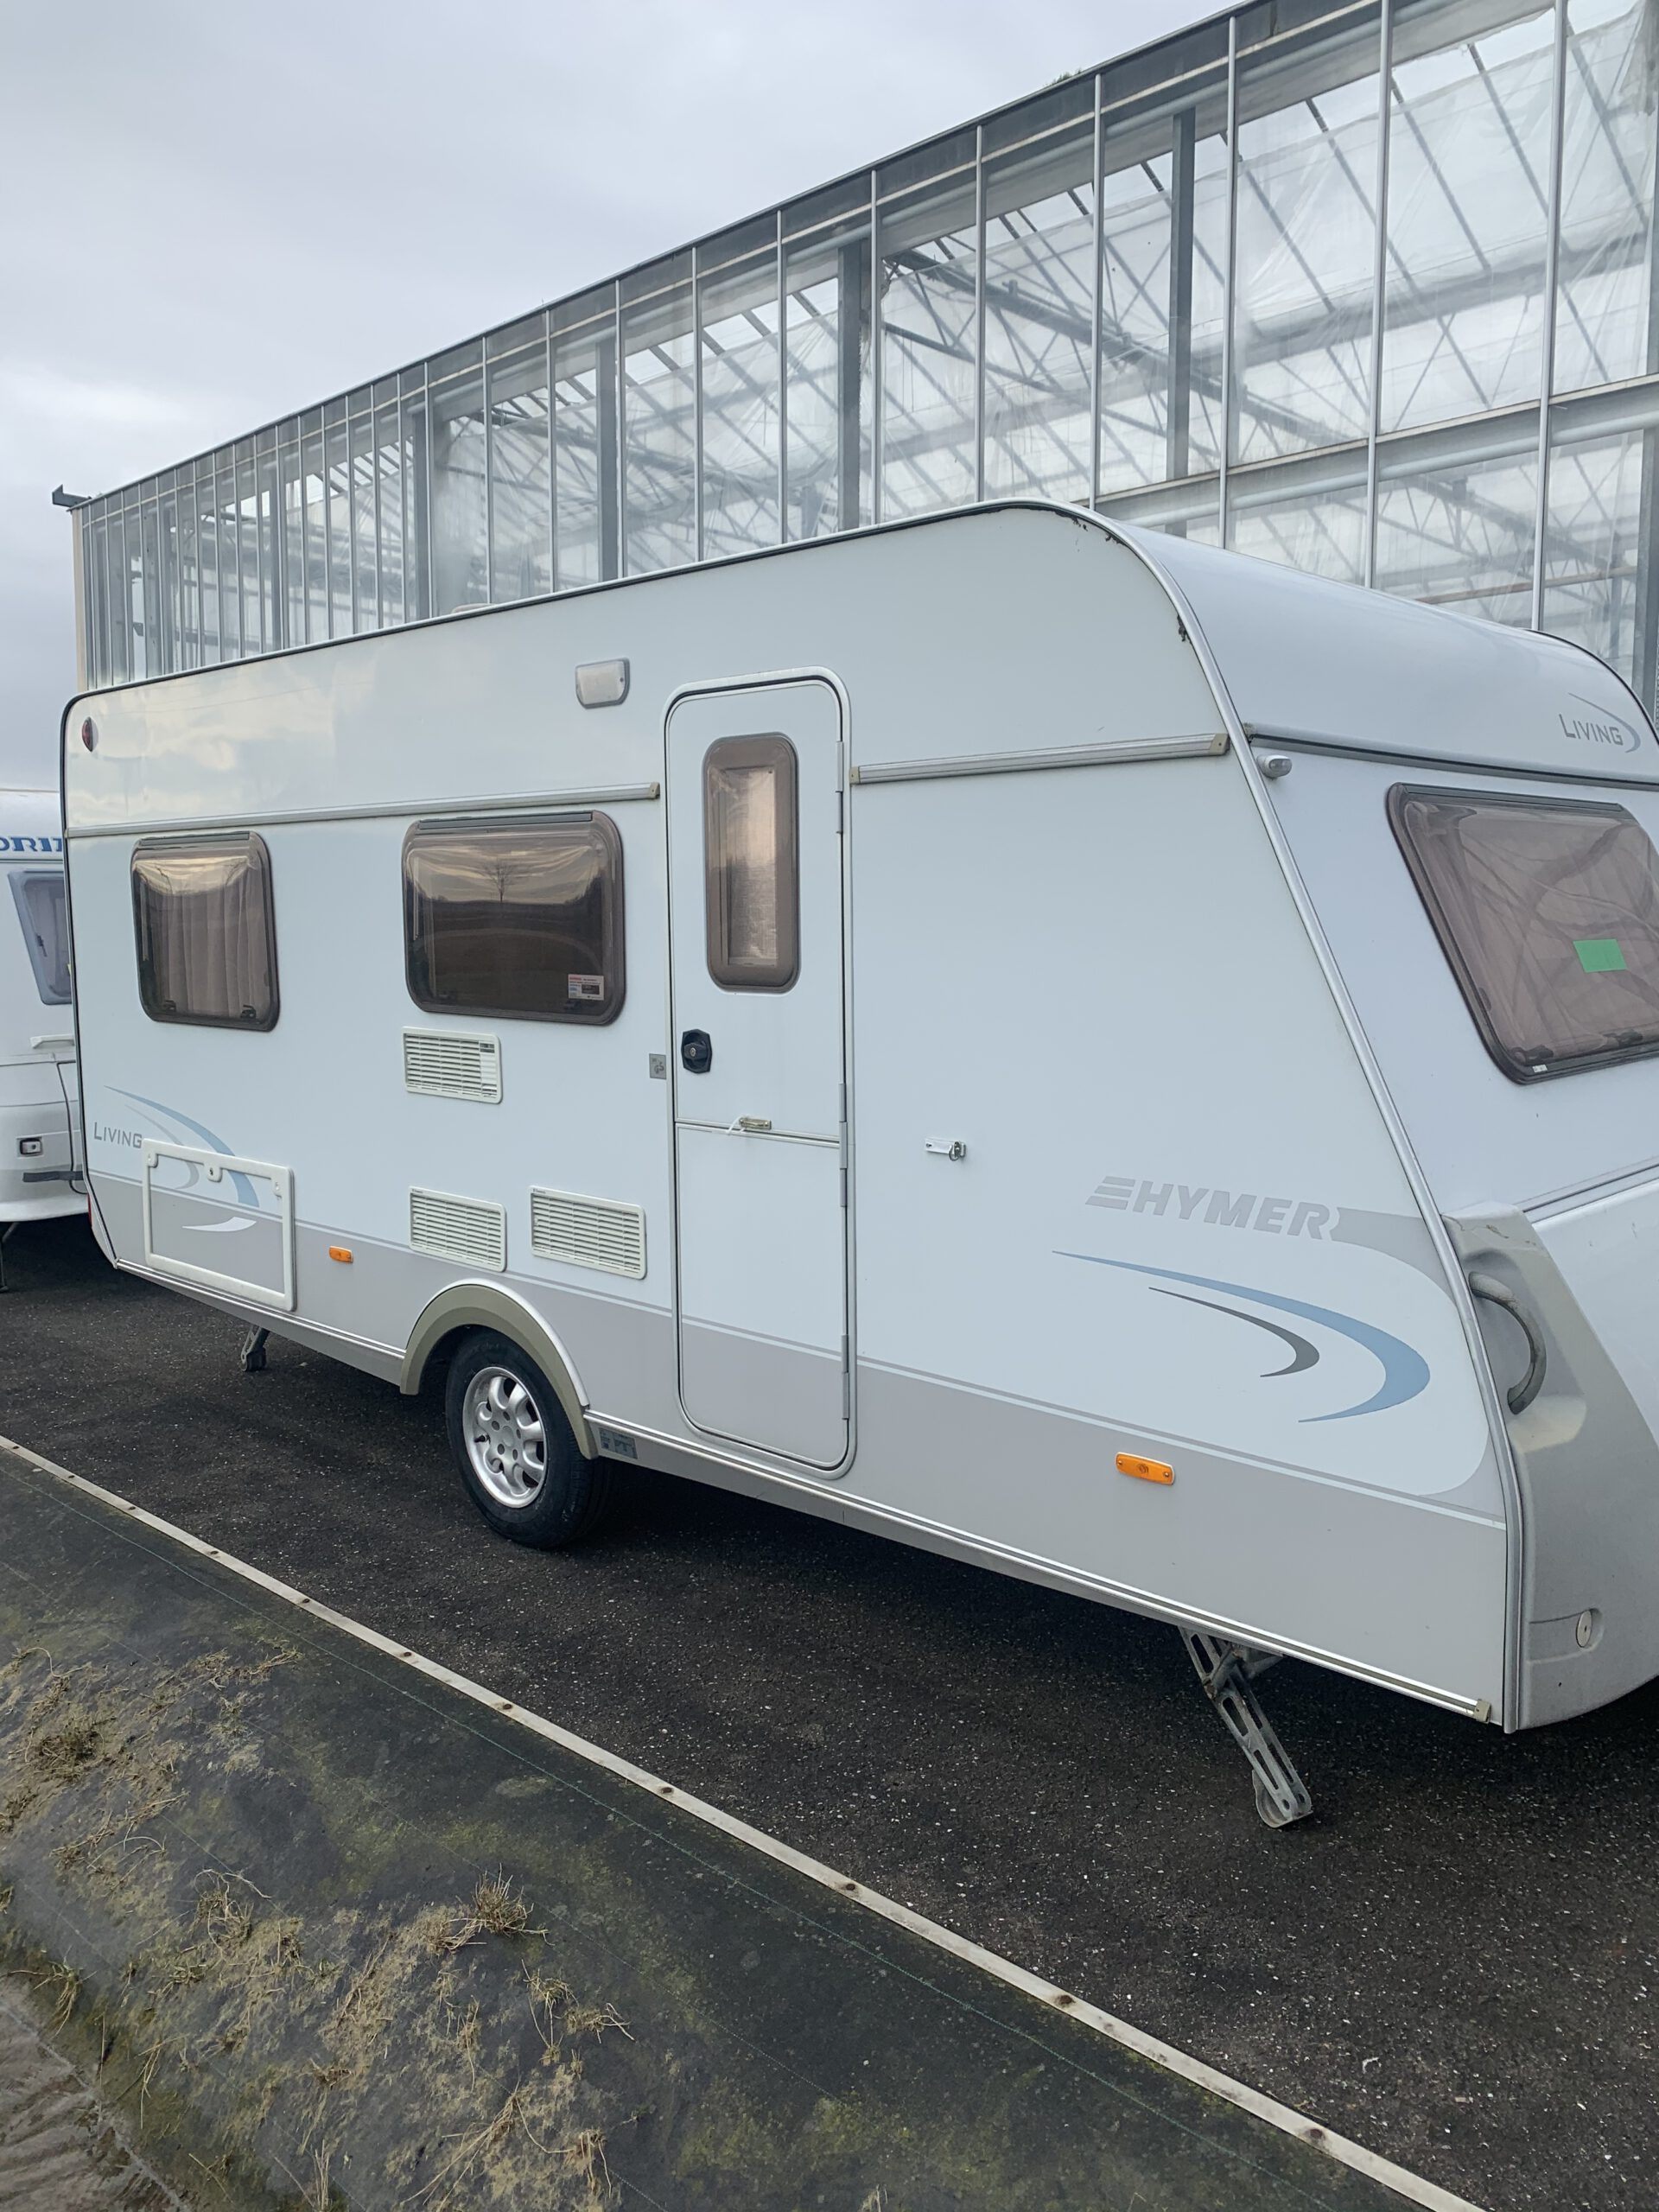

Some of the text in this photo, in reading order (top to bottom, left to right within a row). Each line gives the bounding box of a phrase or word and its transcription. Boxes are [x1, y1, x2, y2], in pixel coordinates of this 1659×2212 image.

[1558, 713, 1624, 746] LIVING
[93, 1122, 143, 1149] LIVING
[1132, 1180, 1331, 1240] HYMER
